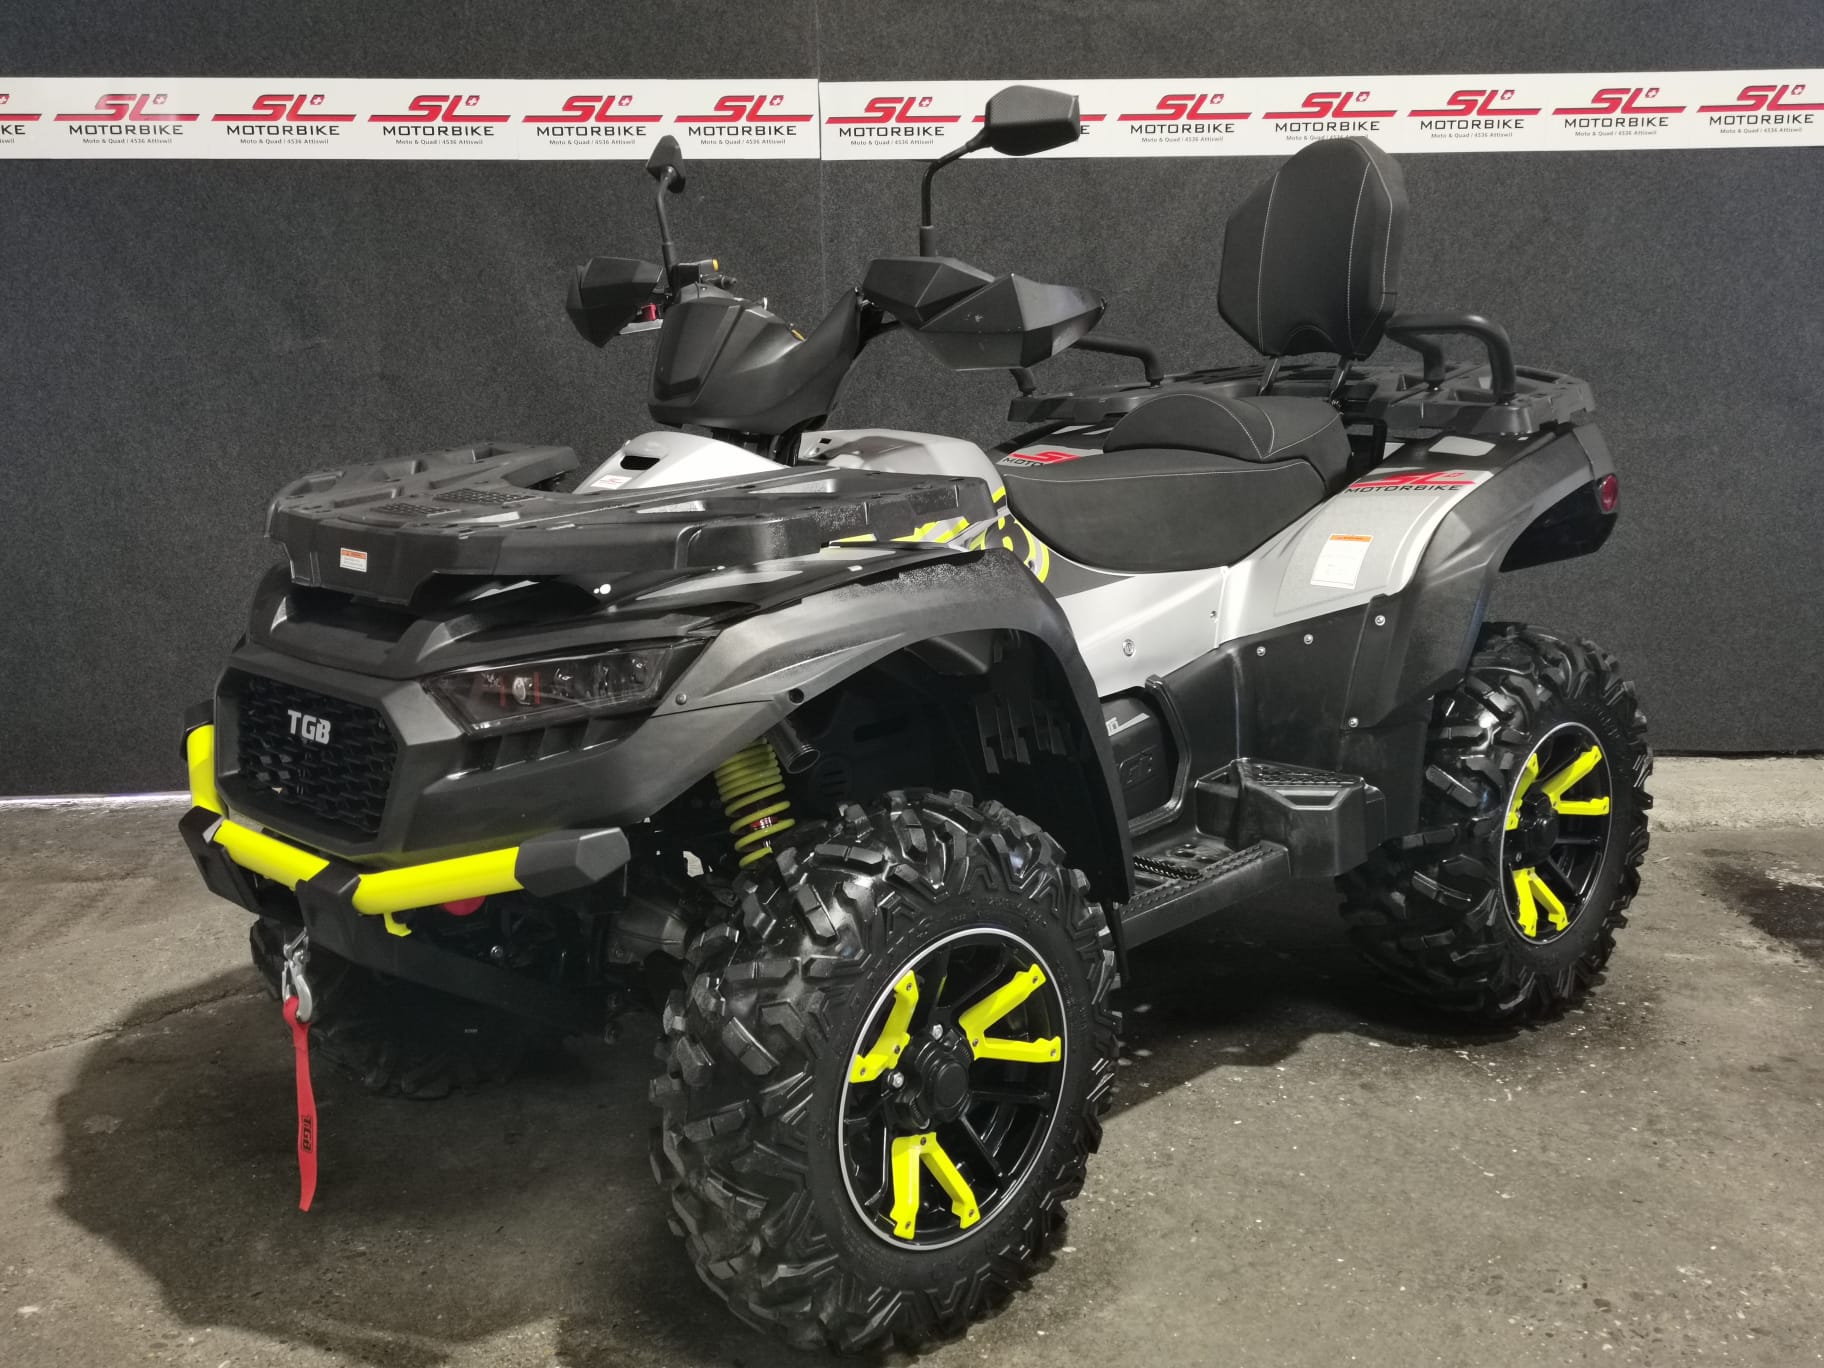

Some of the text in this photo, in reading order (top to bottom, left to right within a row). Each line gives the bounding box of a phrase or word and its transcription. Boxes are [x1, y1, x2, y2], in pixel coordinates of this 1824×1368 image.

[1420, 119, 1524, 130] MOTORBIKE
[1564, 117, 1669, 129] MOTORBIKE
[1709, 114, 1814, 126] MOTORBIKE
[69, 125, 184, 136] MOTORBIKE
[226, 125, 340, 136] MOTORBIKE
[382, 126, 495, 137] MOTORBIKE
[536, 126, 647, 137] MOTORBIKE
[688, 126, 797, 137] MOTORBIKE
[1130, 124, 1235, 134] MOTORBIKE
[1275, 121, 1380, 132] MOTORBIKE
[839, 127, 945, 138] MOTORBIKE
[1344, 485, 1462, 493] MOTORBIKE
[288, 709, 331, 744] TGB
